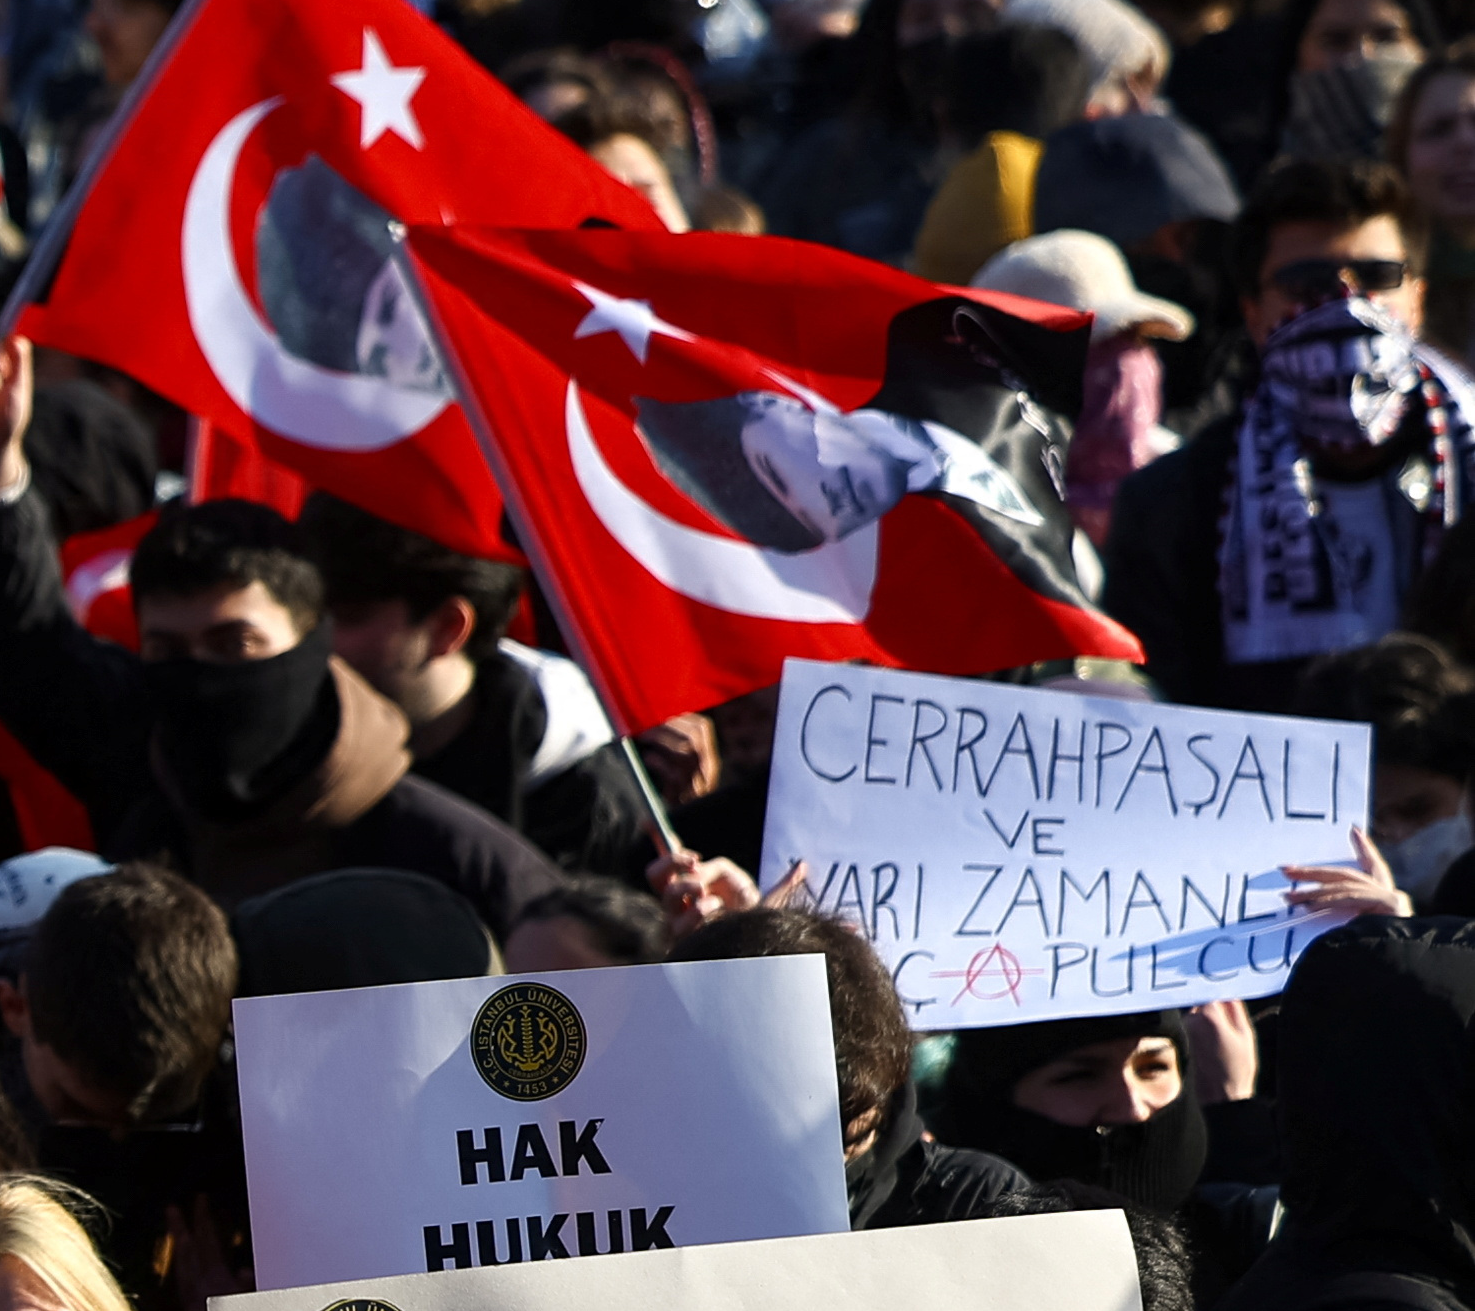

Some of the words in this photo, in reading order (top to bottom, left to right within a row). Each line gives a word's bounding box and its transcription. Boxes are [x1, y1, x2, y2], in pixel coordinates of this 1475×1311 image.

[800, 683, 1341, 825] CERRAHPAŞALI
[982, 808, 1067, 857] VE
[517, 1081, 548, 1094] 1453
[456, 1118, 613, 1186] HAK
[423, 1205, 676, 1273] HUKUK
